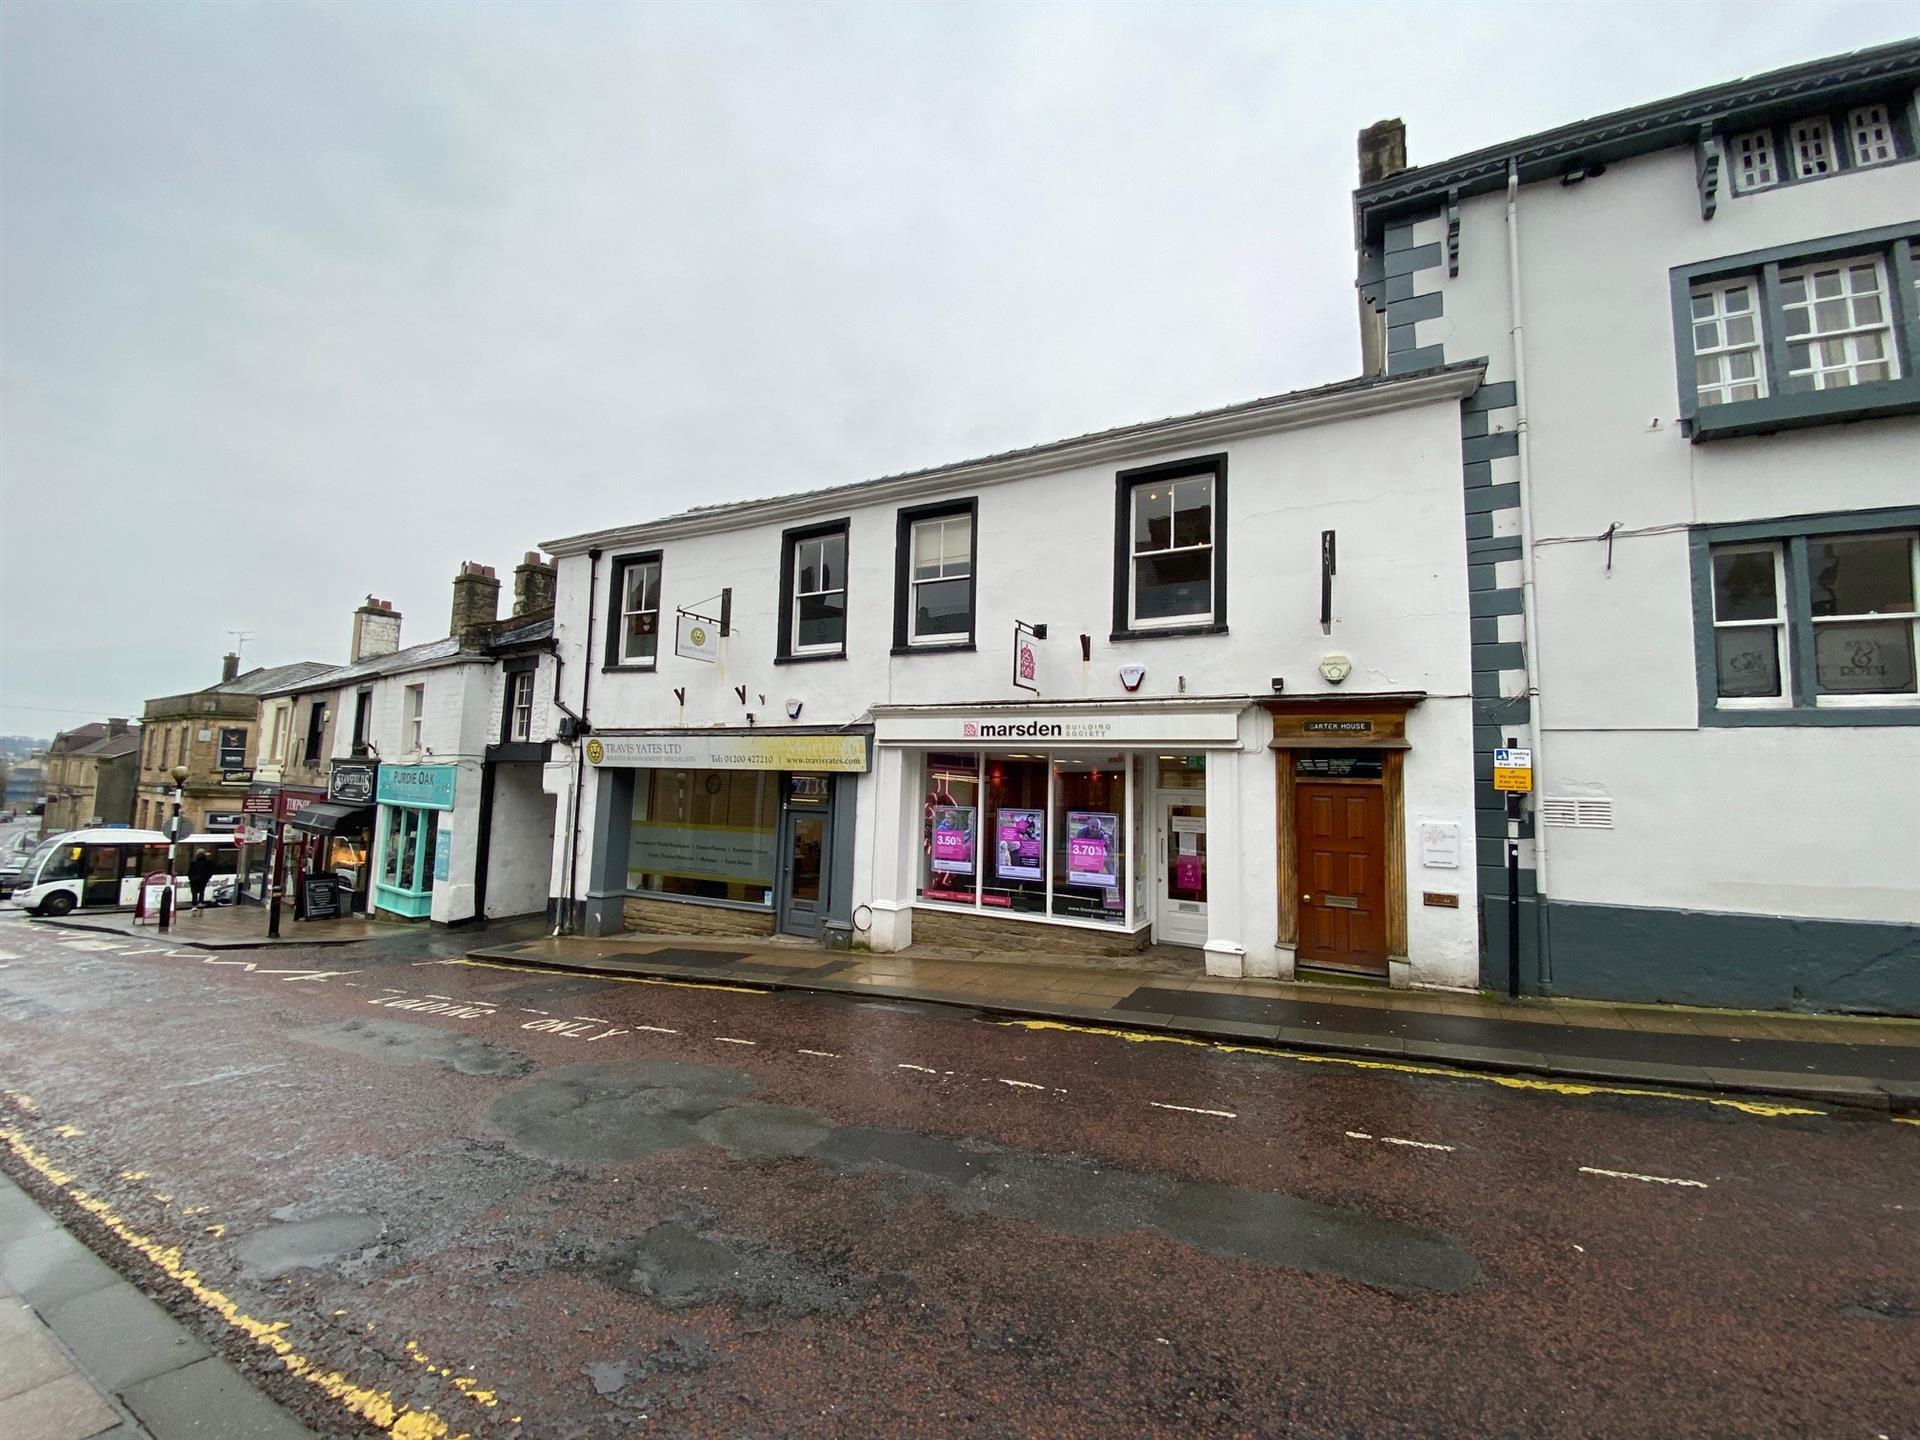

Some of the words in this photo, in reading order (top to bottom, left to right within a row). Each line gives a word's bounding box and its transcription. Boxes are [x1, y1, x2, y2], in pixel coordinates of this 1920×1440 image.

[980, 720, 1062, 737] marsden
[605, 743, 635, 754] TRAVIS
[636, 743, 662, 754] YATES
[663, 743, 682, 754] LTD
[711, 755, 723, 763] Tel:
[724, 755, 746, 763] 01200
[747, 755, 774, 764] 427210
[786, 756, 861, 765] www.travisyates.com
[393, 771, 417, 785] PURDIE
[418, 771, 435, 786] OAK
[520, 1018, 630, 1041] ONLY
